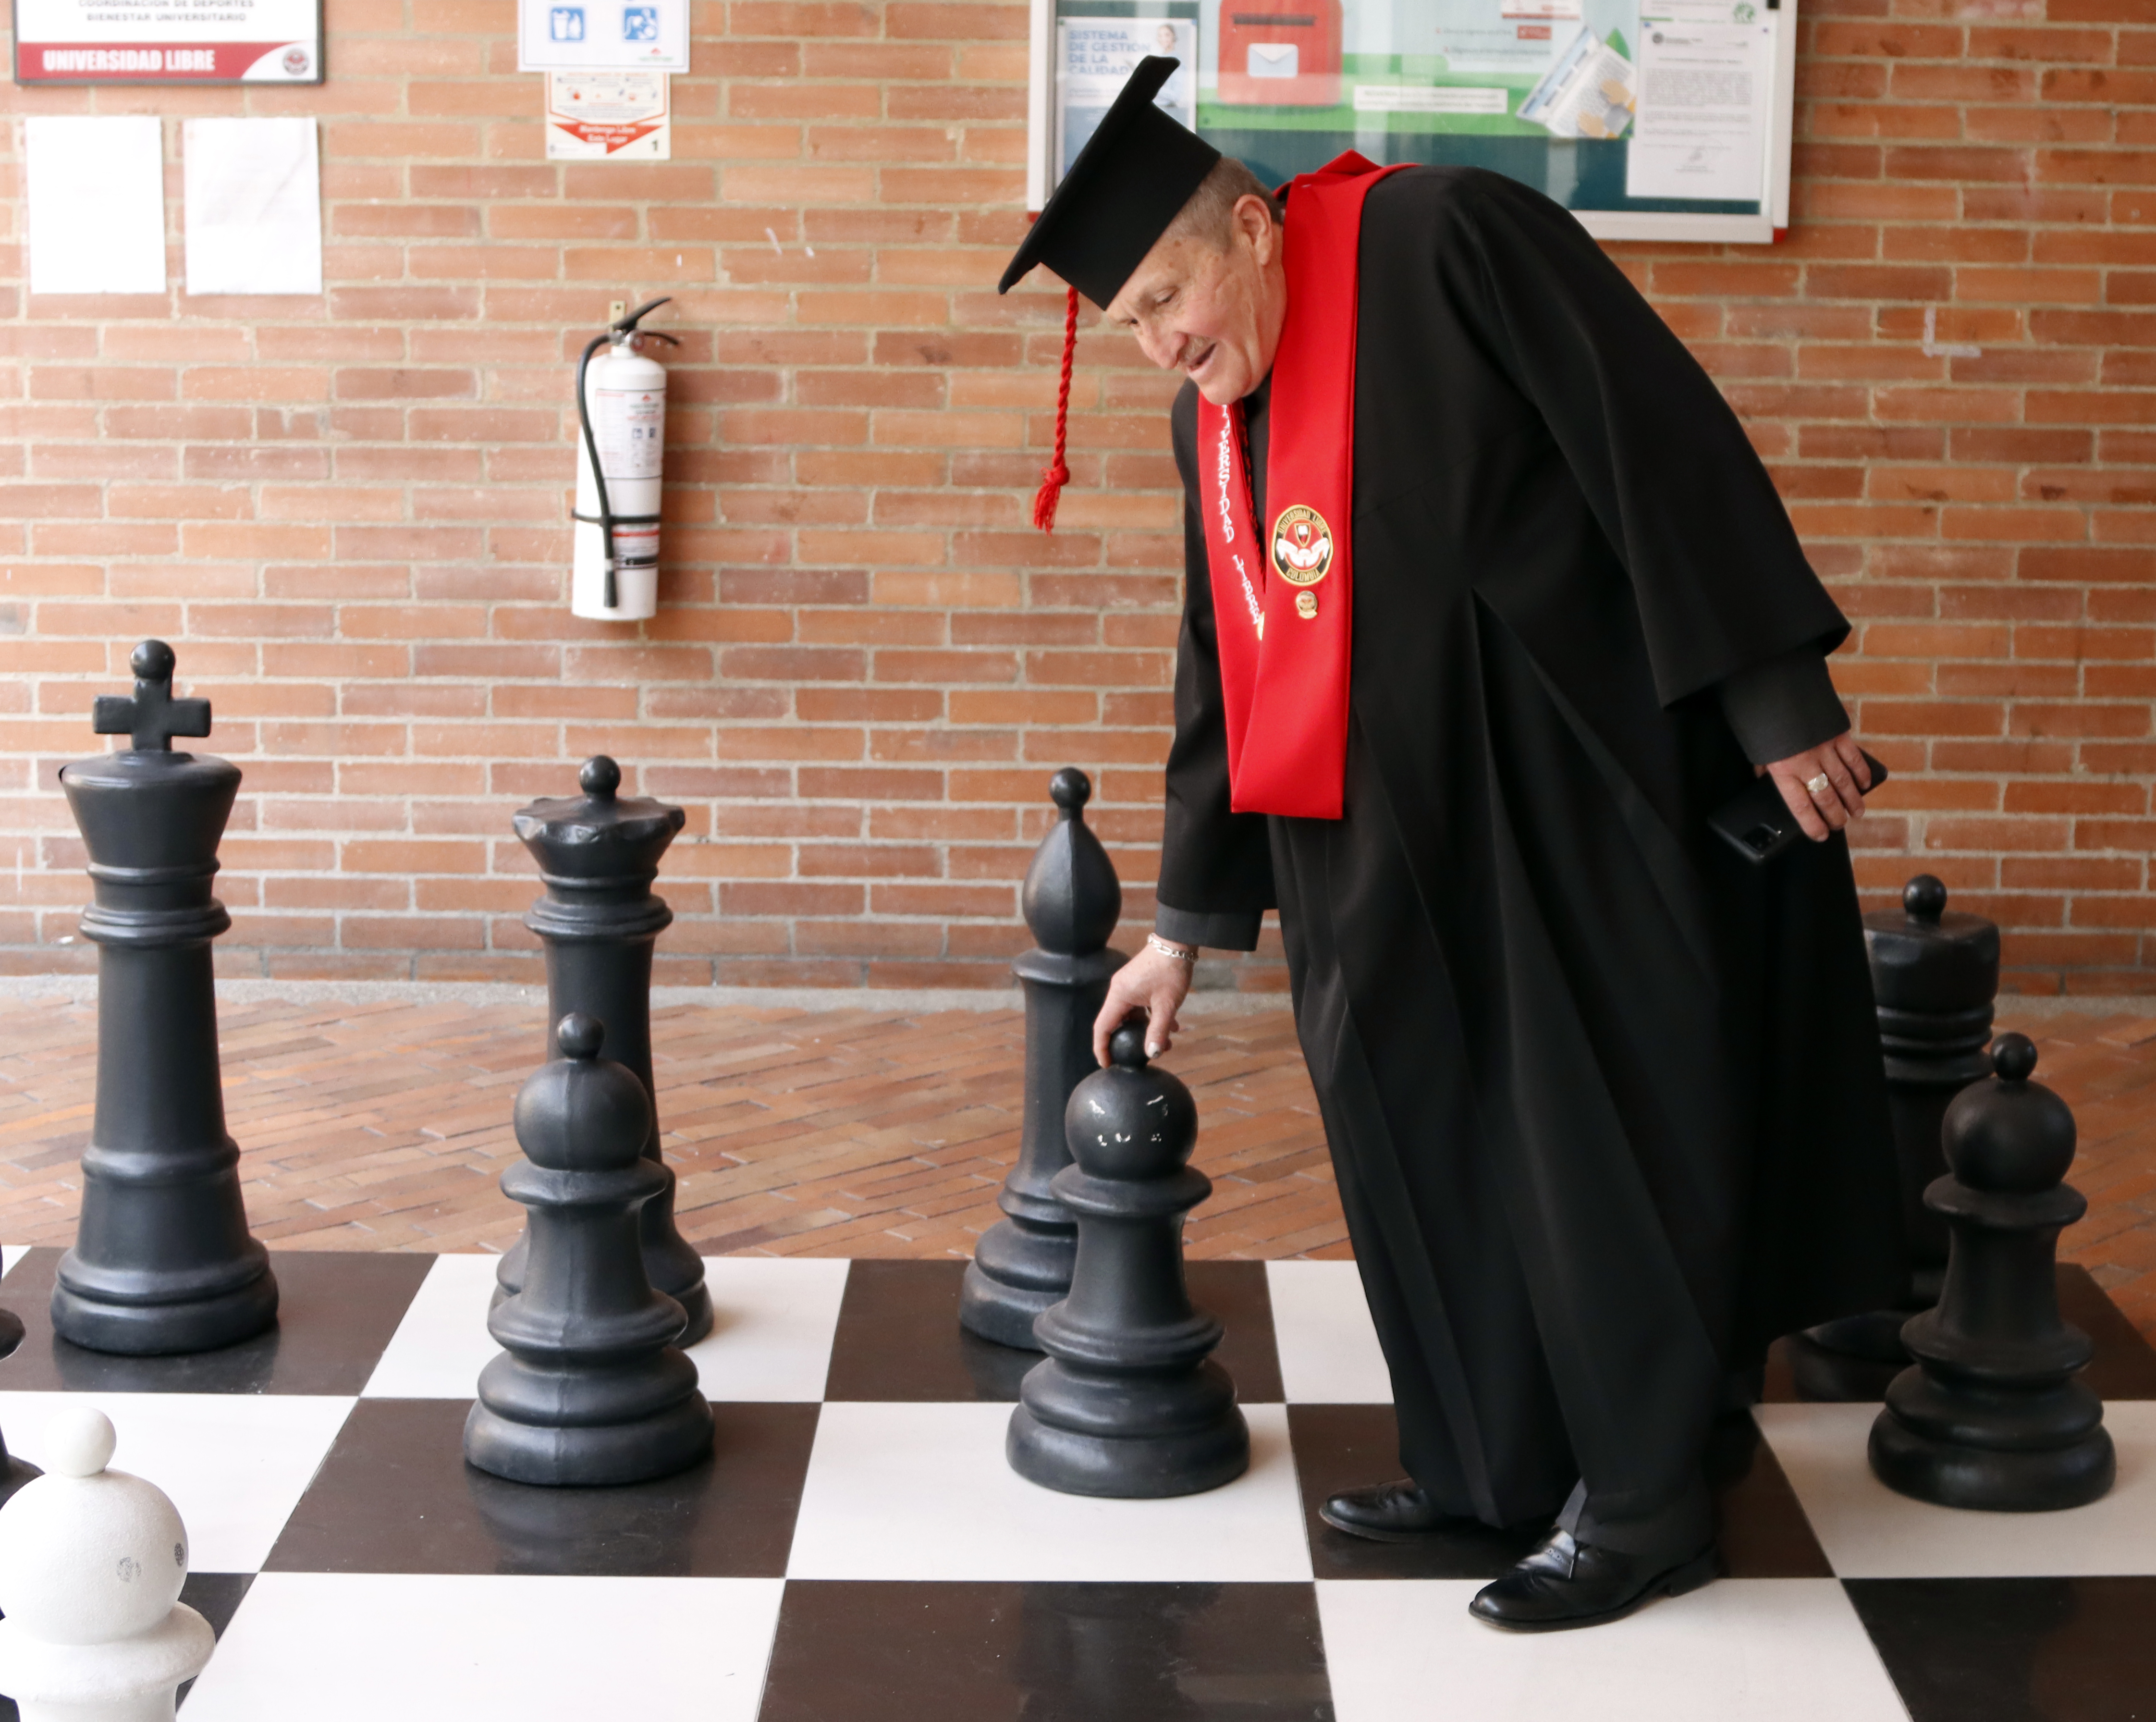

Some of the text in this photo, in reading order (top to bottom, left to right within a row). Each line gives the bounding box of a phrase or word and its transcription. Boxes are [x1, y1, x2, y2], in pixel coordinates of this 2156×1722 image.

[87, 13, 247, 21] BIENESTAR UNIVERSITARIO
[1069, 30, 1128, 39] SISTEMA
[1069, 40, 1151, 52] DE GESTIÓN
[43, 49, 215, 71] UNIVERSIDAD LIBRE
[1069, 53, 1108, 63] DE LA
[1069, 65, 1129, 75] CALIDAD
[651, 139, 658, 151] 1
[1278, 509, 1311, 534] UNIVERSIDAD
[1286, 567, 1321, 582] COLOMBIA
[1232, 554, 1261, 625] LIBRE
